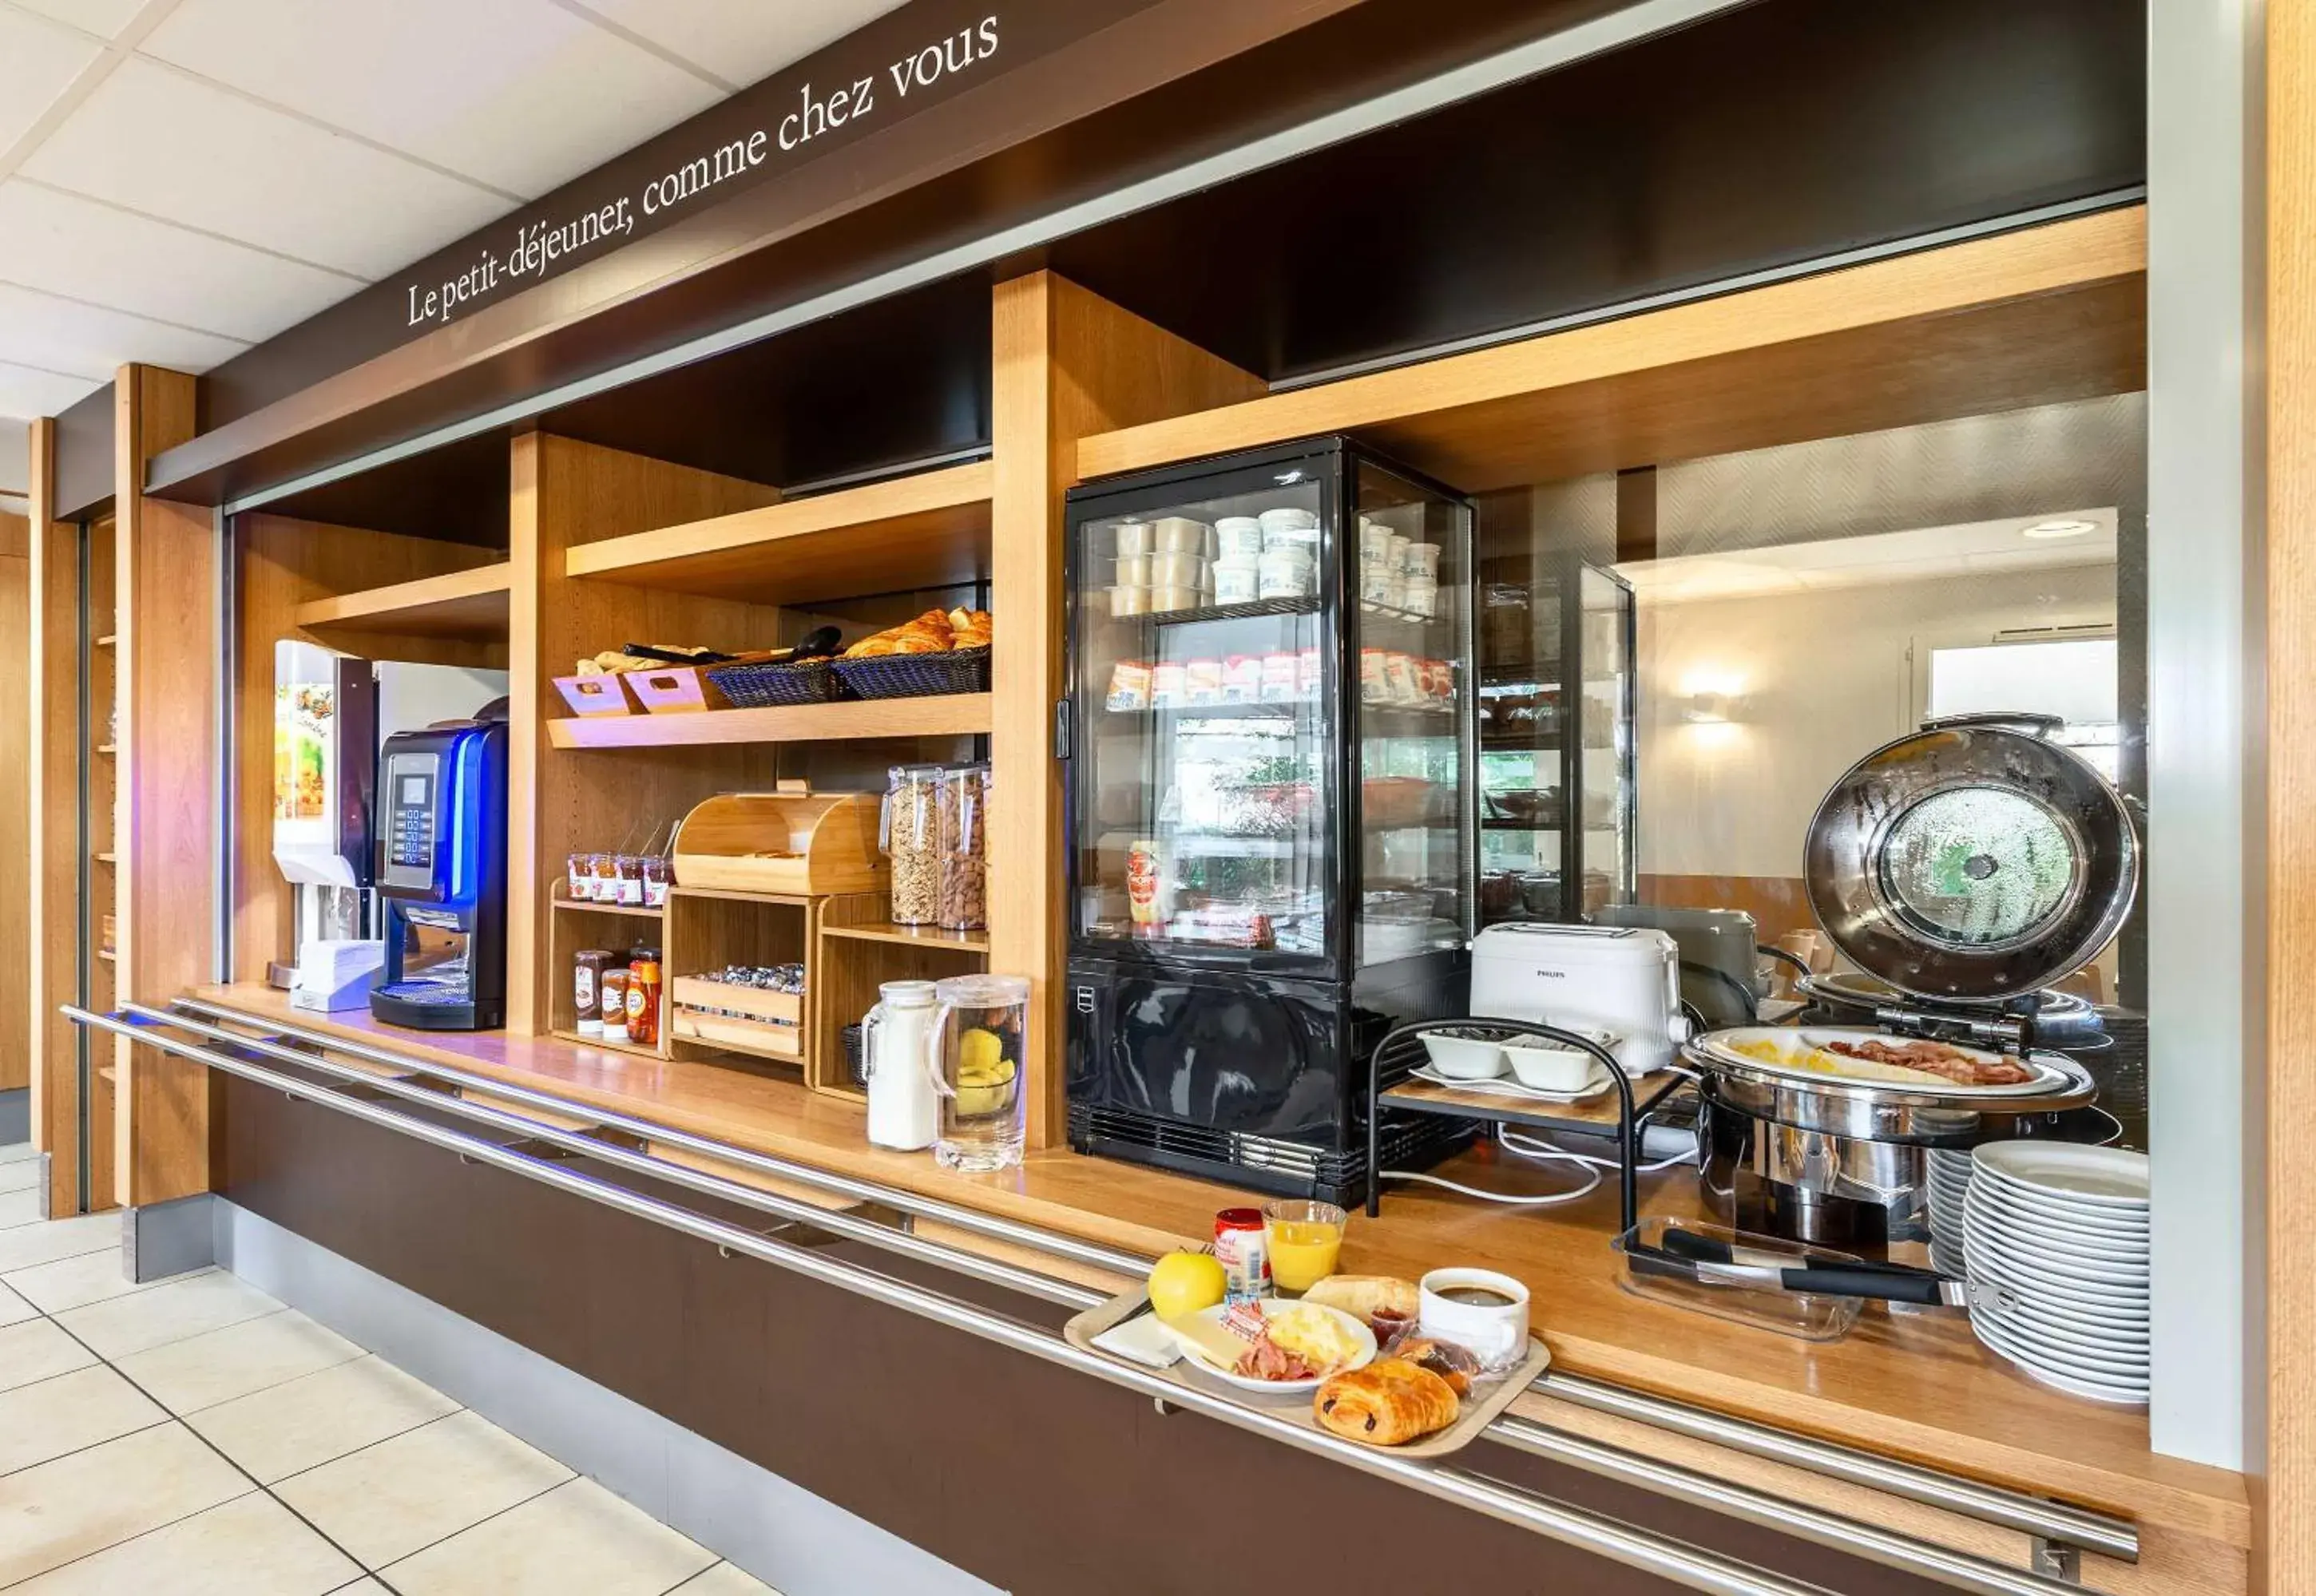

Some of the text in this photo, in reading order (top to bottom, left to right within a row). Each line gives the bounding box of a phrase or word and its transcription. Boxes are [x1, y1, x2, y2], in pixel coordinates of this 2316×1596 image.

[408, 16, 998, 326] Le petit-déjeuner, comme chez vous
